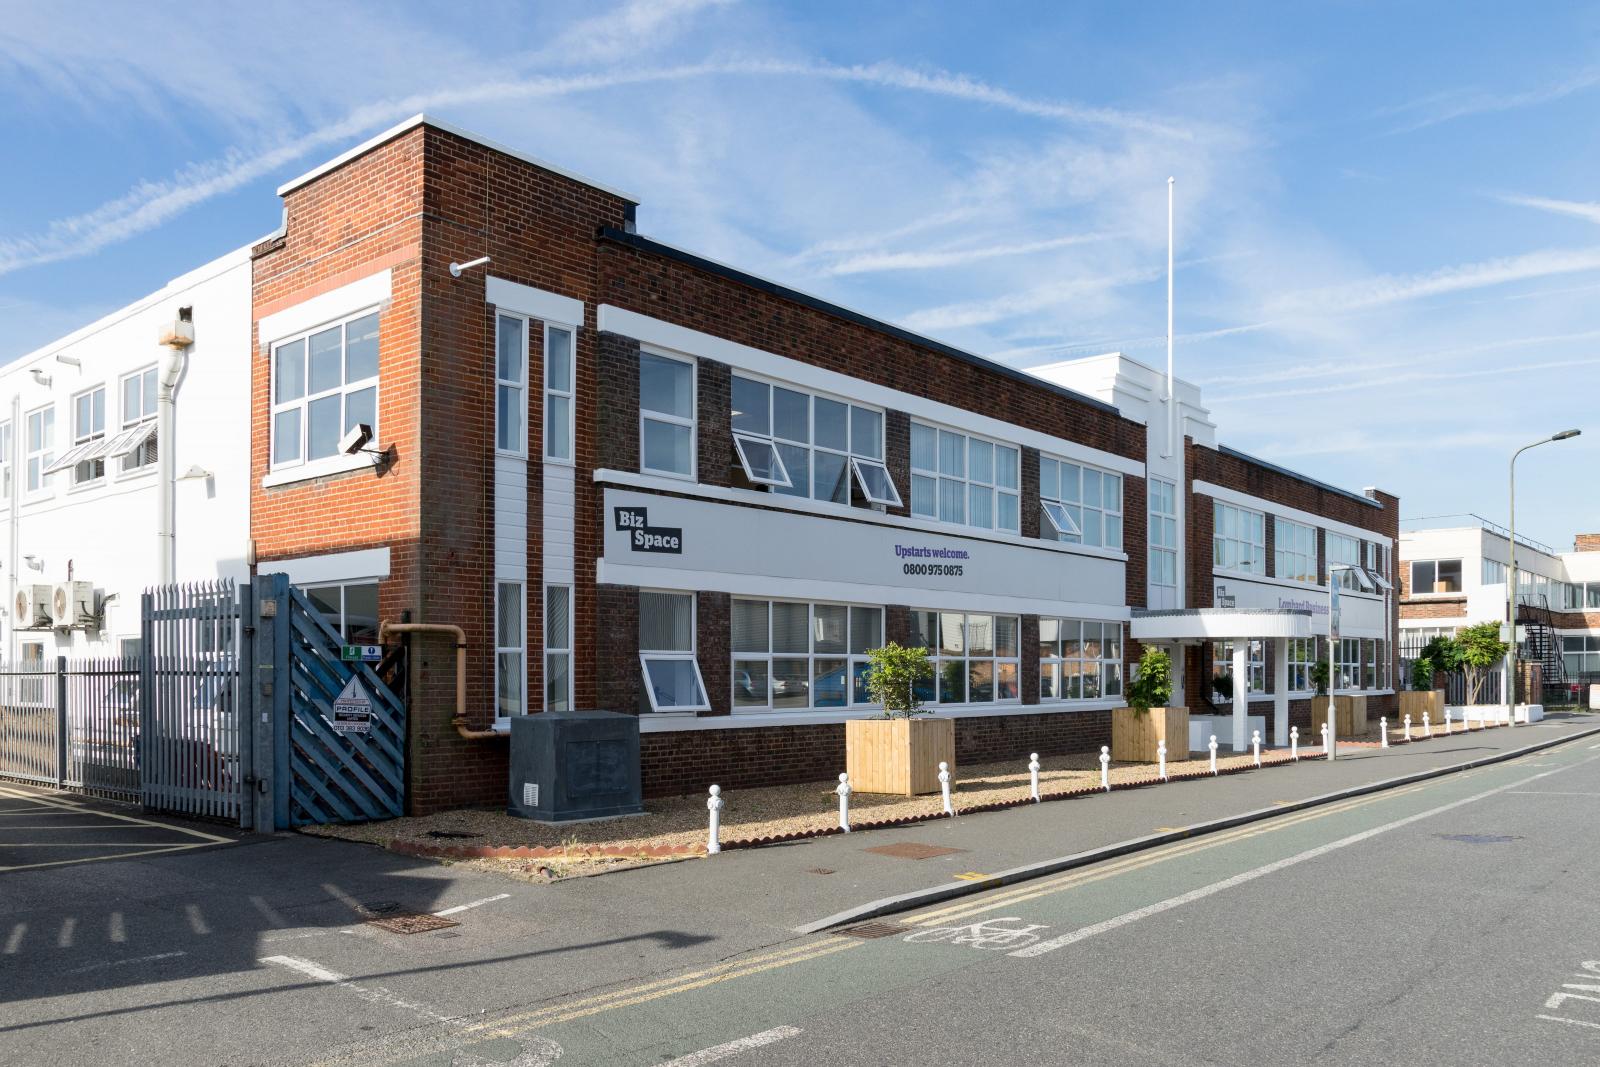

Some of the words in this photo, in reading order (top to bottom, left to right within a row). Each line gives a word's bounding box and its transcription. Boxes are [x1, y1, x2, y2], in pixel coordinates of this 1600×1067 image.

[619, 511, 644, 528] Biz
[635, 530, 679, 549] Space
[895, 544, 931, 559] Upstarts
[932, 548, 970, 559] welcome.
[903, 563, 927, 575] 0800
[928, 564, 942, 575] 975
[943, 565, 963, 576] 0875
